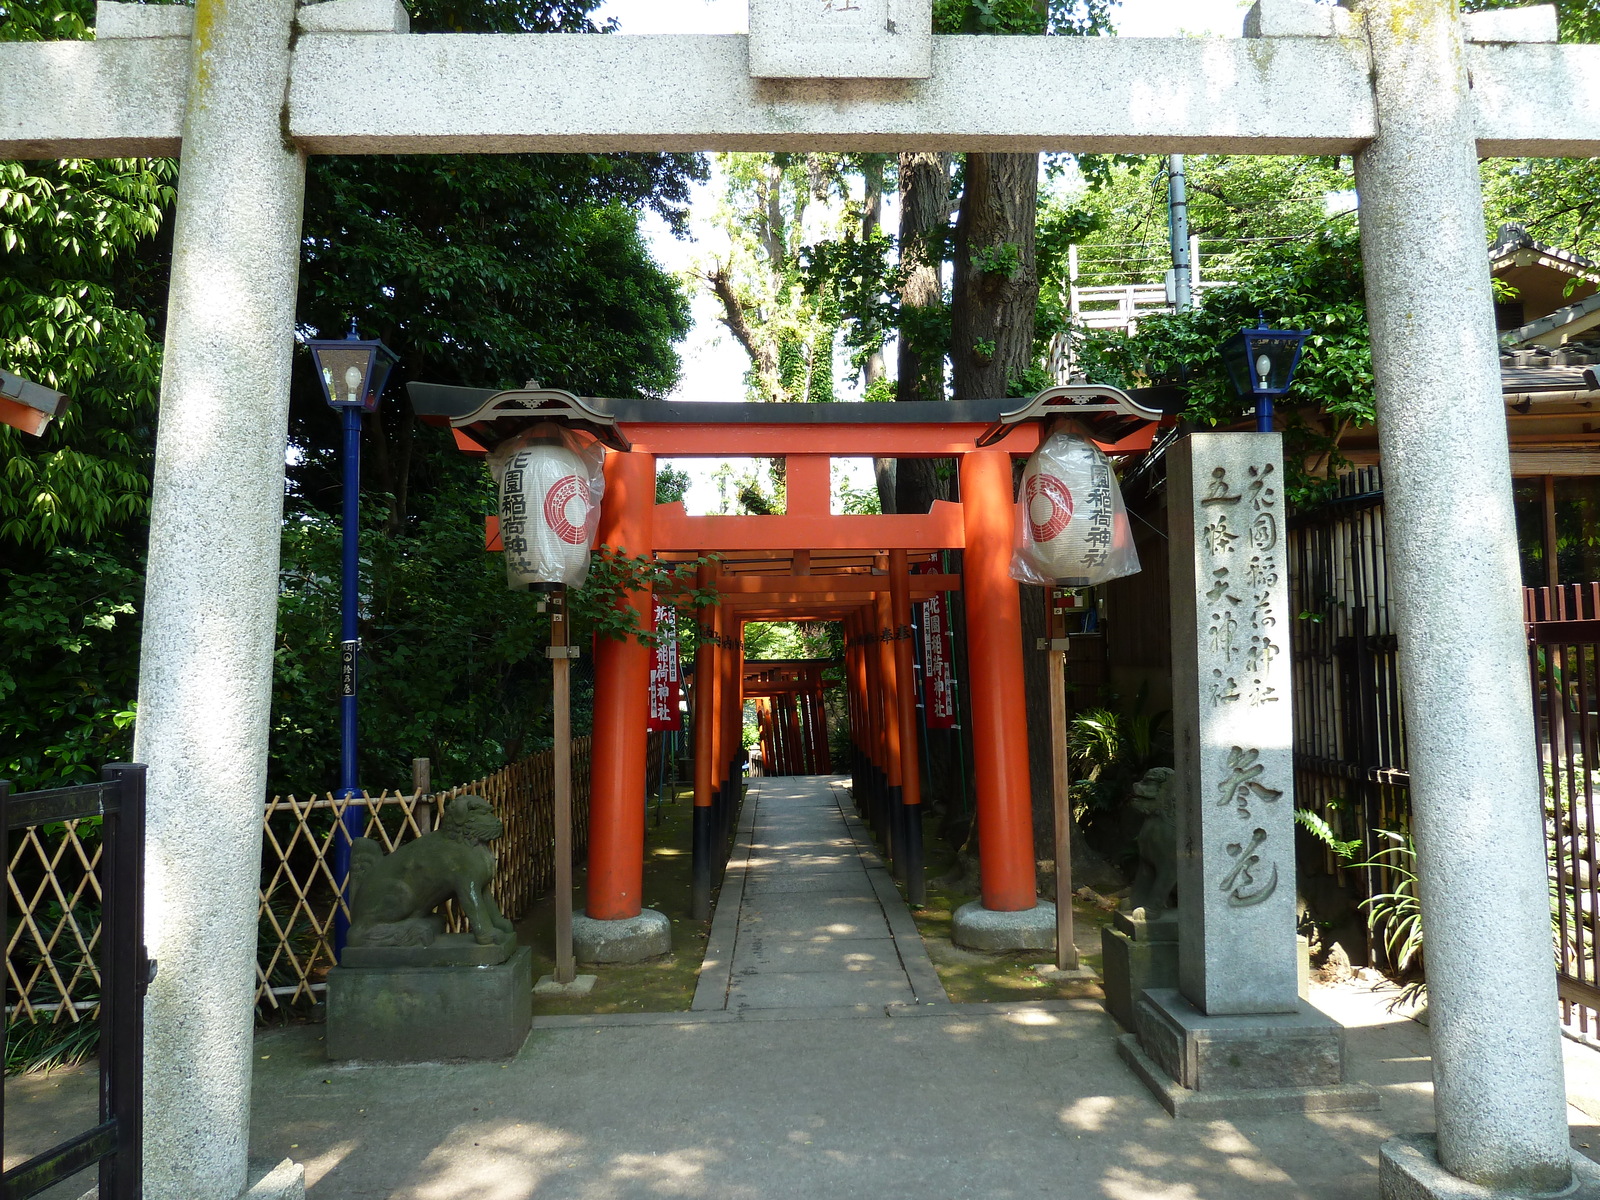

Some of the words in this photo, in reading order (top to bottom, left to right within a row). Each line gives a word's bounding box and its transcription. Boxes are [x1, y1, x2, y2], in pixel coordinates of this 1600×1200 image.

[501, 452, 538, 575] 花園稲荷神社
[653, 605, 671, 720] 花稲荷神社
